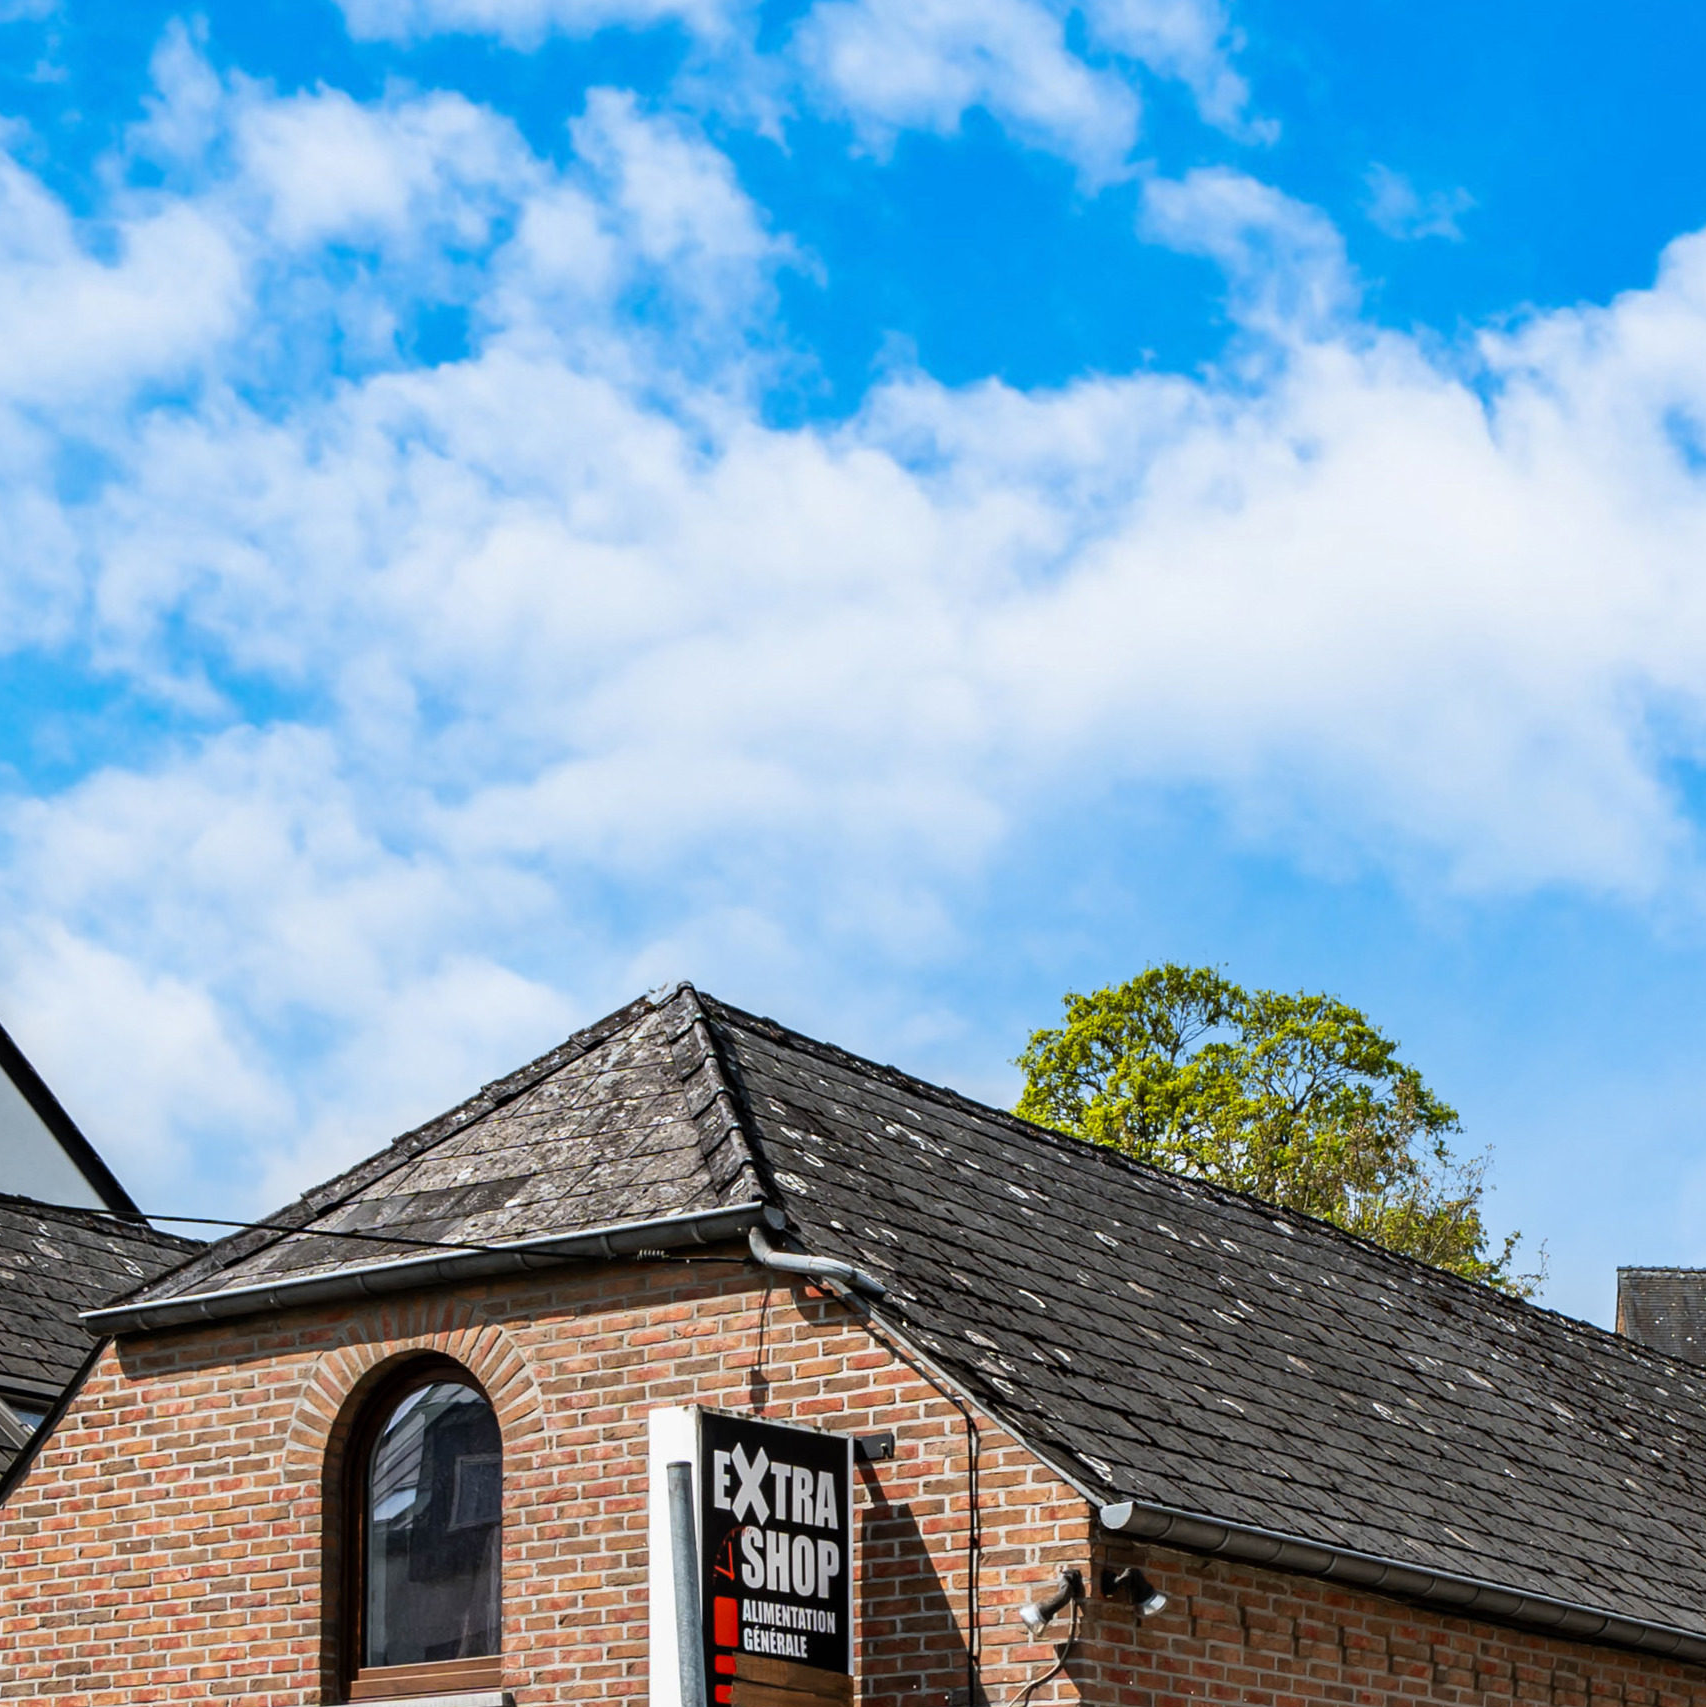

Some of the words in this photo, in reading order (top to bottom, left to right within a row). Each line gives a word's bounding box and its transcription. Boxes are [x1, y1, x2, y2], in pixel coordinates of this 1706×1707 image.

[714, 1442, 838, 1530] EXTRA
[741, 1525, 839, 1599] SHOP
[743, 1598, 836, 1634] ALIMENTATION
[744, 1626, 808, 1658] GÉNÉRALE
